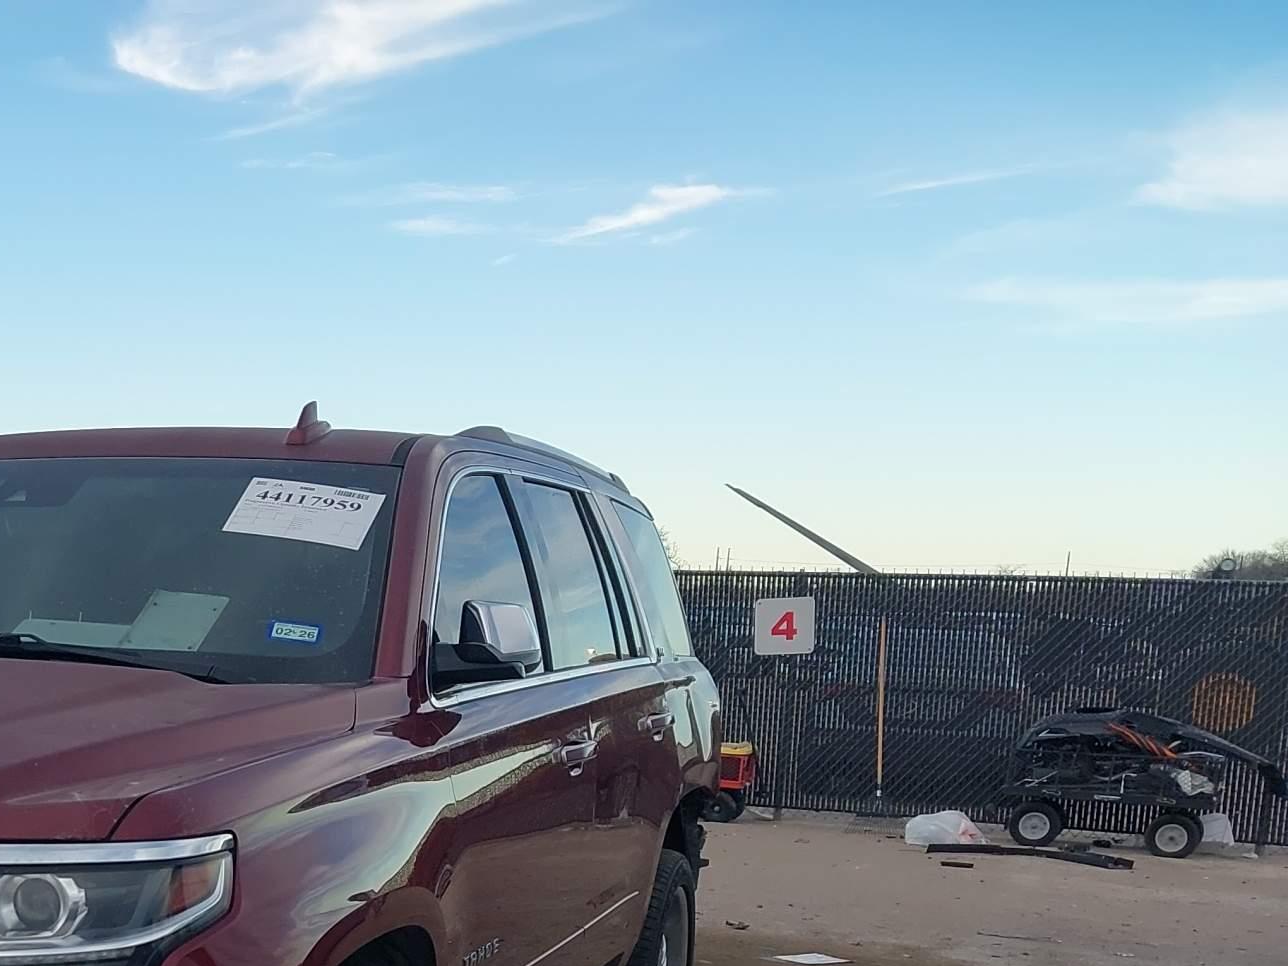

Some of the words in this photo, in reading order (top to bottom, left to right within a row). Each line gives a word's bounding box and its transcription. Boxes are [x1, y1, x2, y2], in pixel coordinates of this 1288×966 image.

[256, 490, 362, 512] 44117959
[275, 627, 293, 637] 02
[298, 629, 316, 639] 26
[770, 611, 798, 641] 4
